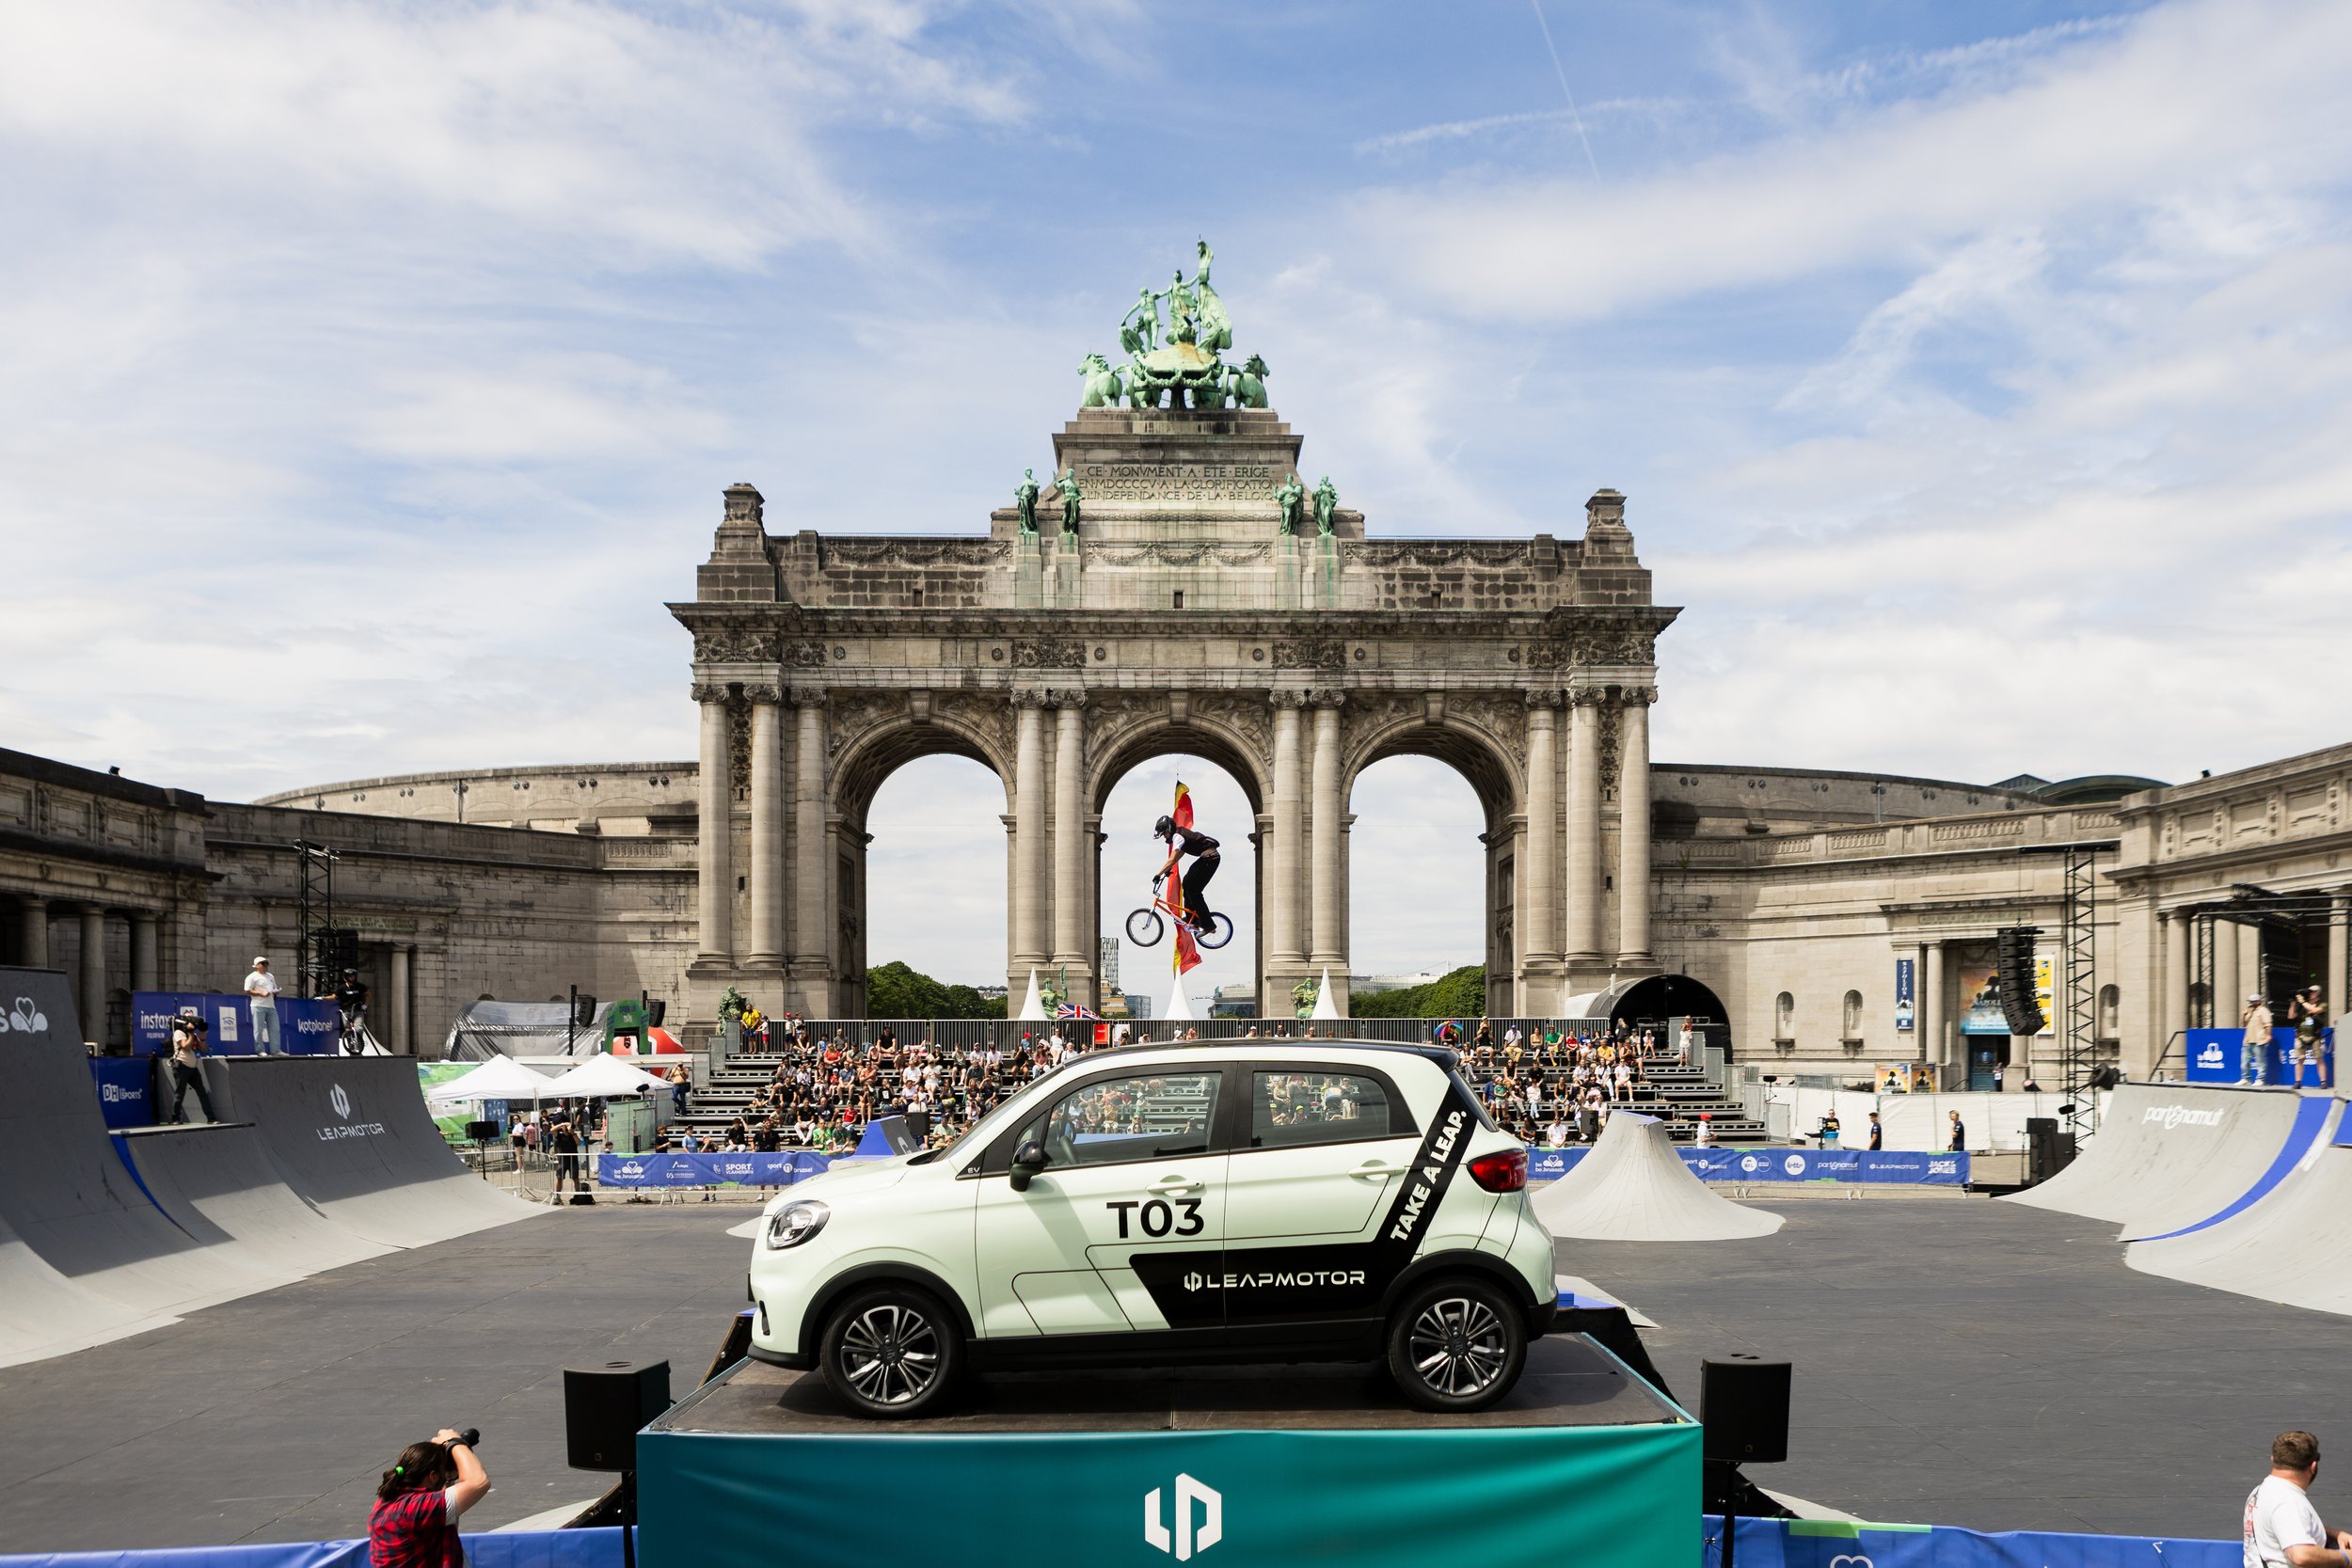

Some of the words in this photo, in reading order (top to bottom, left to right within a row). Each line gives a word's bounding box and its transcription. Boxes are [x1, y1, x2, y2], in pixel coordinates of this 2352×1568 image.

[1087, 467, 1103, 477] CE
[1187, 467, 1197, 478] A
[1204, 467, 1226, 478] ETE
[1234, 467, 1270, 478] ERIGE
[1160, 480, 1168, 488] A
[1174, 480, 1190, 489] LA
[1187, 491, 1202, 500] DE
[1207, 491, 1222, 500] LA
[1229, 491, 1274, 500] BELGIQ
[317, 1123, 386, 1141] LEAPMOTOR
[1430, 1111, 1467, 1163] LEAP.
[1422, 1166, 1442, 1185] A
[1106, 1197, 1204, 1239] T03
[1390, 1182, 1431, 1241] TAKE
[1207, 1271, 1365, 1288] LEAPMOTOR
